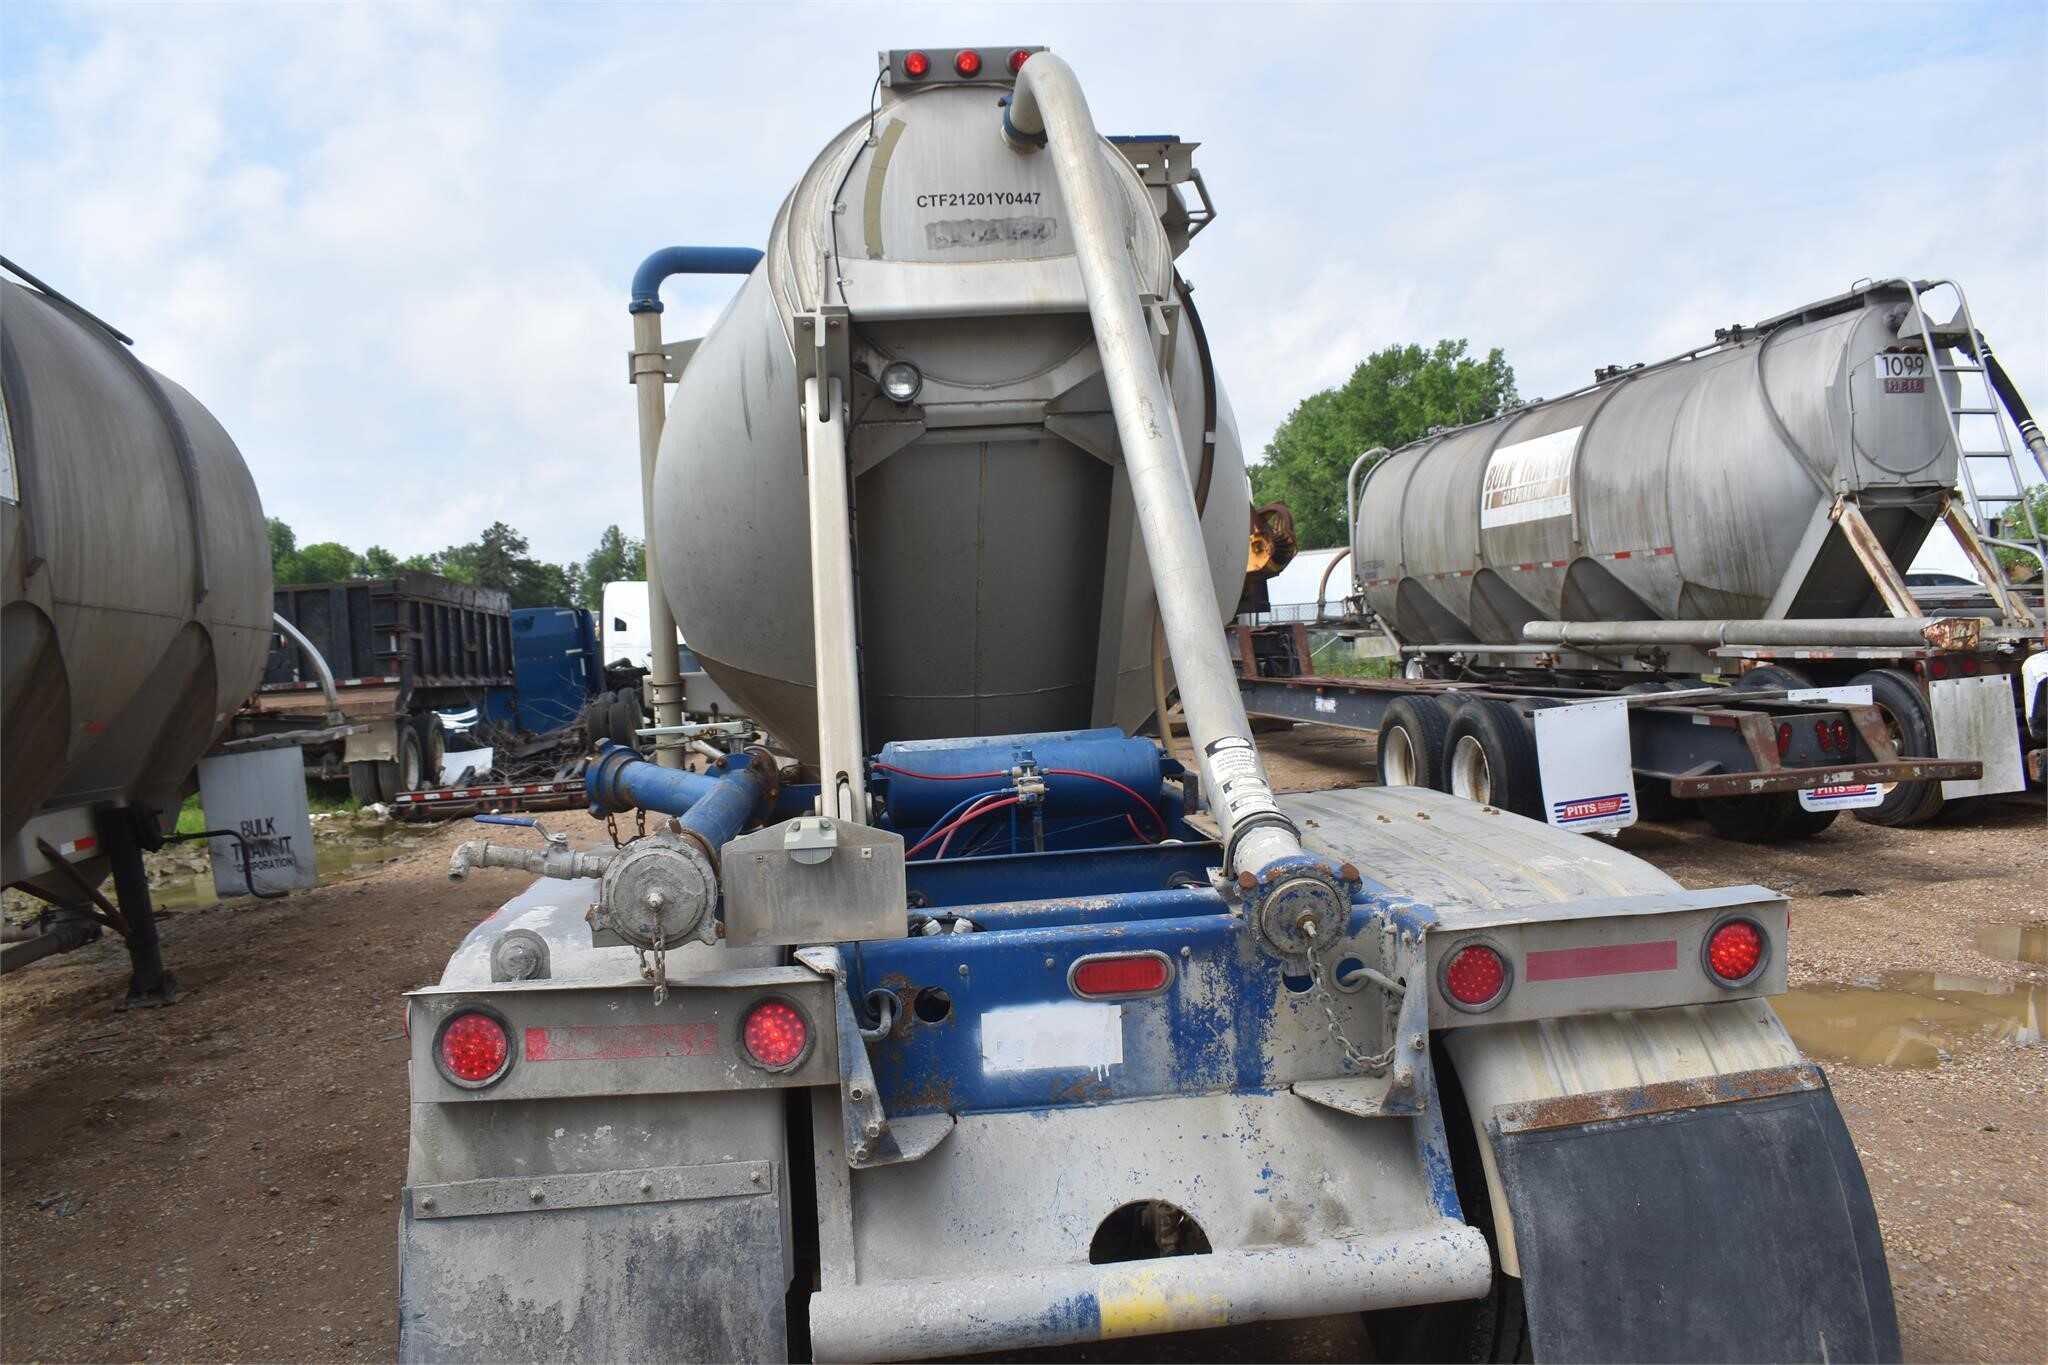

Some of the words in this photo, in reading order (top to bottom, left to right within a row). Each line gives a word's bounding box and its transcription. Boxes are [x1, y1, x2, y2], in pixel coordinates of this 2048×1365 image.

[917, 192, 1041, 208] CTF21201Y0447
[1882, 355, 1924, 376] 1099
[1566, 803, 1597, 816] PITTS
[240, 817, 276, 838] BULK
[231, 836, 292, 861] TANSIT
